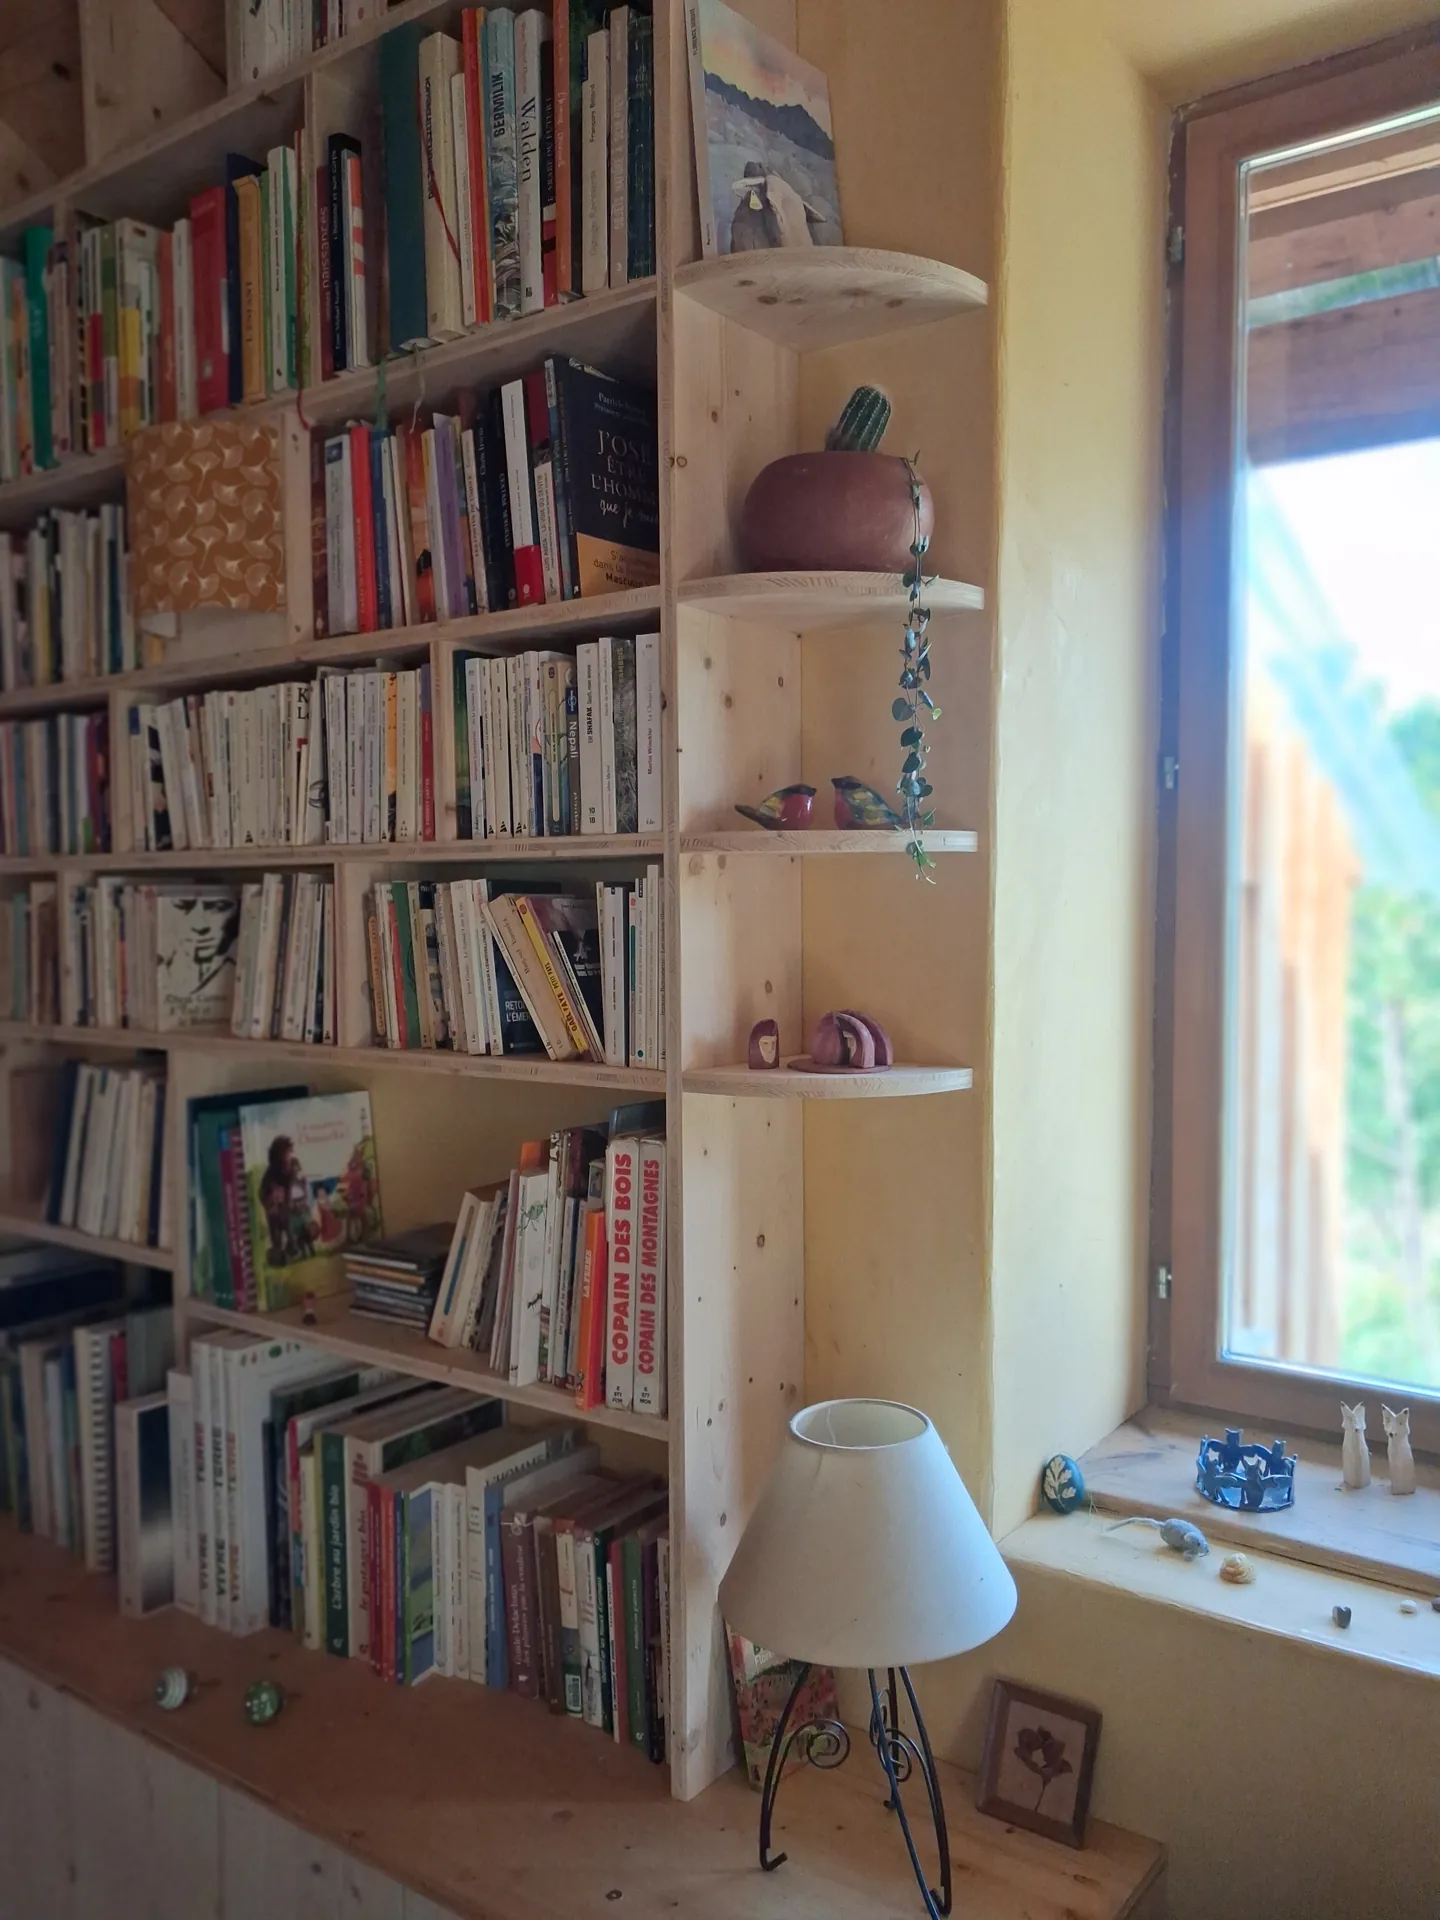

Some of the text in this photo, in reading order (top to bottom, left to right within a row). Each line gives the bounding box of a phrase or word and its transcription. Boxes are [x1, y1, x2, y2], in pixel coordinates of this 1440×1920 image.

[491, 71, 506, 138] SERMILIK
[520, 96, 537, 183] Walden
[319, 205, 331, 289] naissances
[599, 497, 619, 516] que
[568, 721, 579, 759] Nepali
[544, 962, 560, 990] PETIT PAYS
[557, 991, 570, 1012] FAYE
[611, 1153, 632, 1366] COPAIN DES BOIS
[637, 1159, 659, 1375] COPAIN DES MONTAGNES
[212, 1426, 223, 1489] TERRE
[216, 1537, 227, 1596] VIVRE
[329, 1484, 343, 1610] L'arbre au jardin bio
